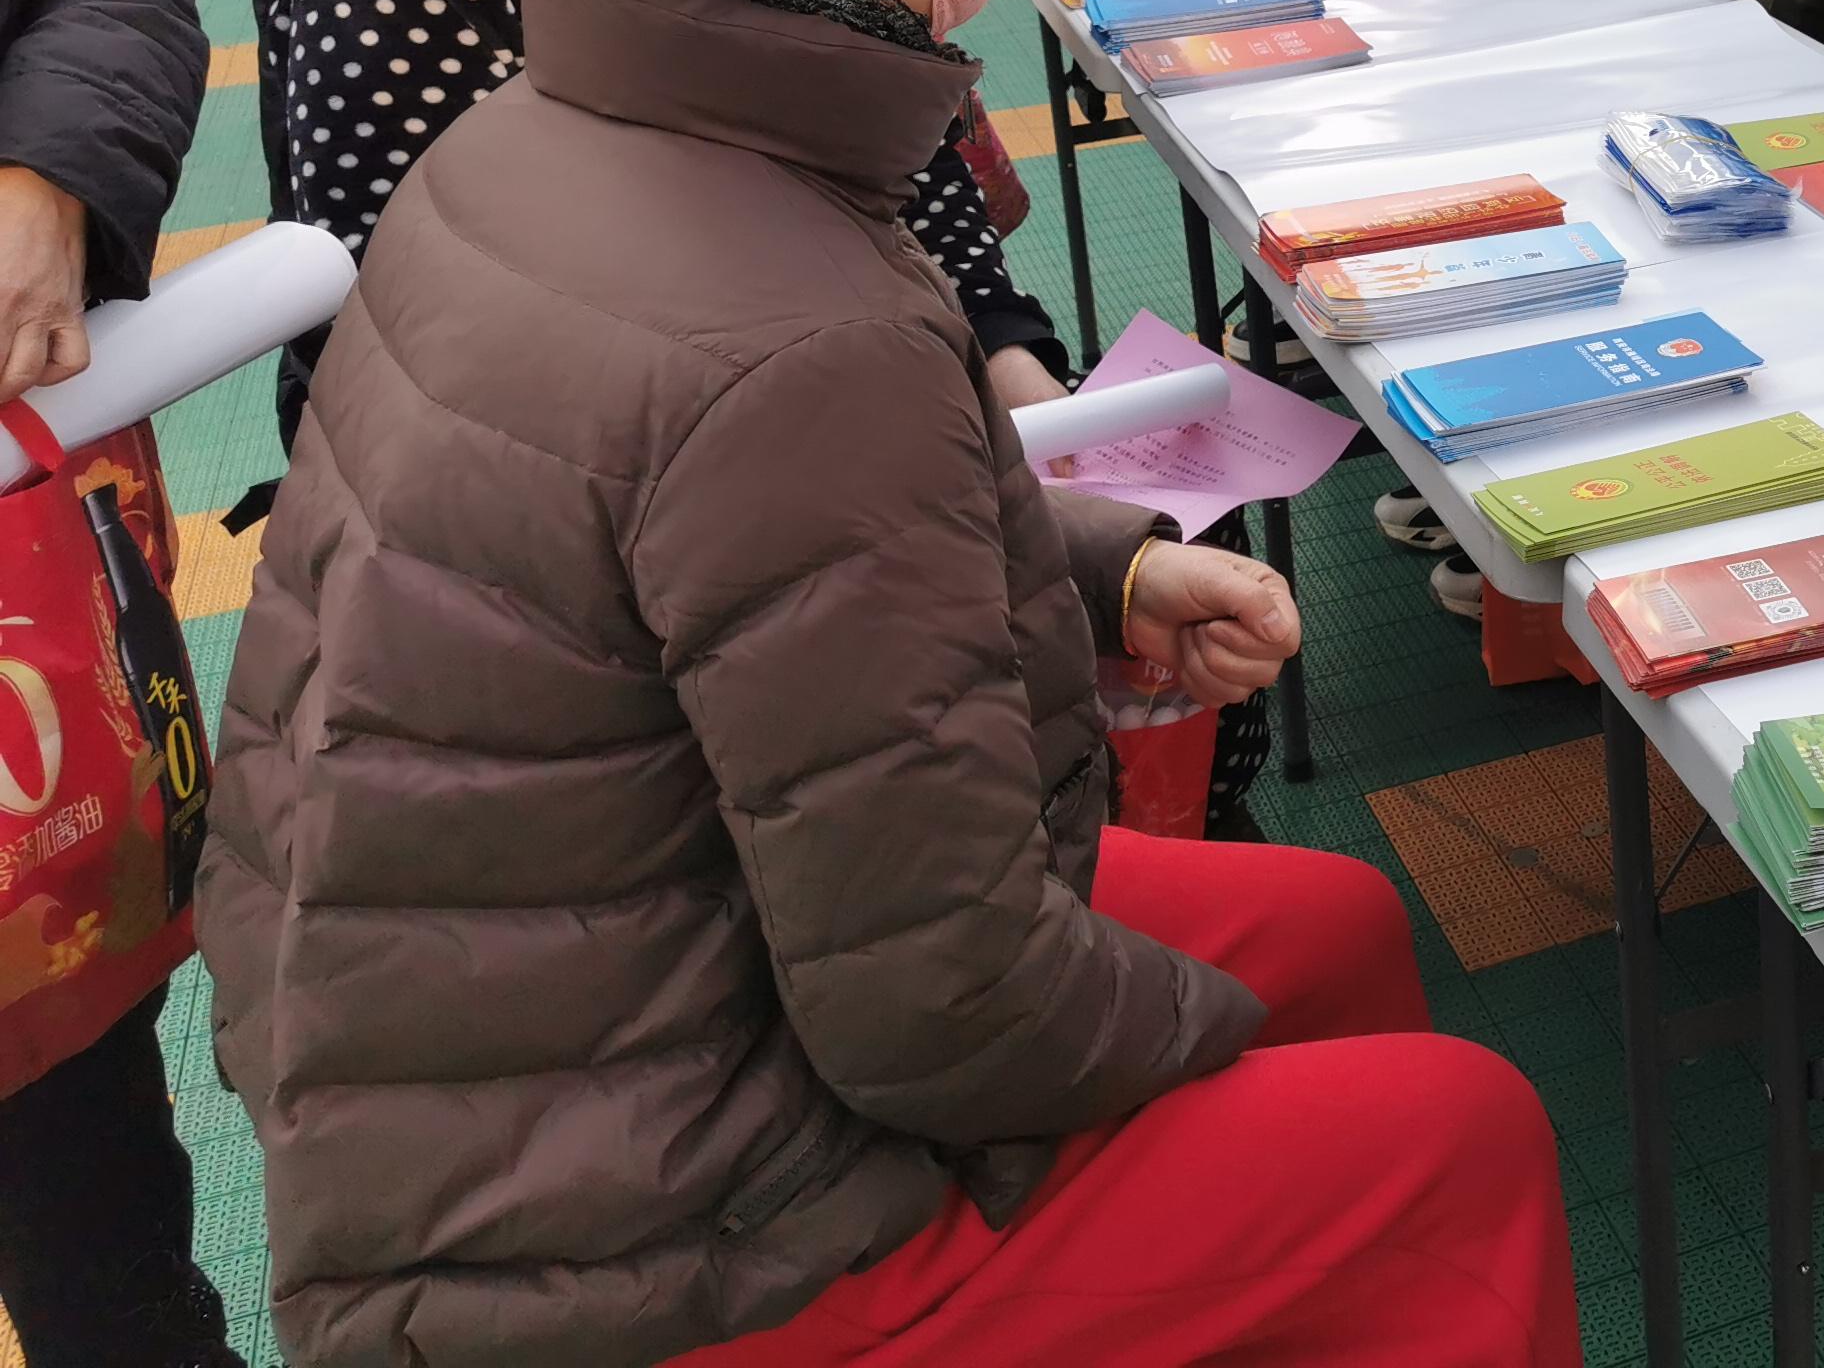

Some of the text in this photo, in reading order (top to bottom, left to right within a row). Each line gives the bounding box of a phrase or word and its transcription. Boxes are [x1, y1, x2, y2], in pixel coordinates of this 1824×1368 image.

[1584, 340, 1643, 384] 服务指南
[146, 672, 188, 713] 千禾
